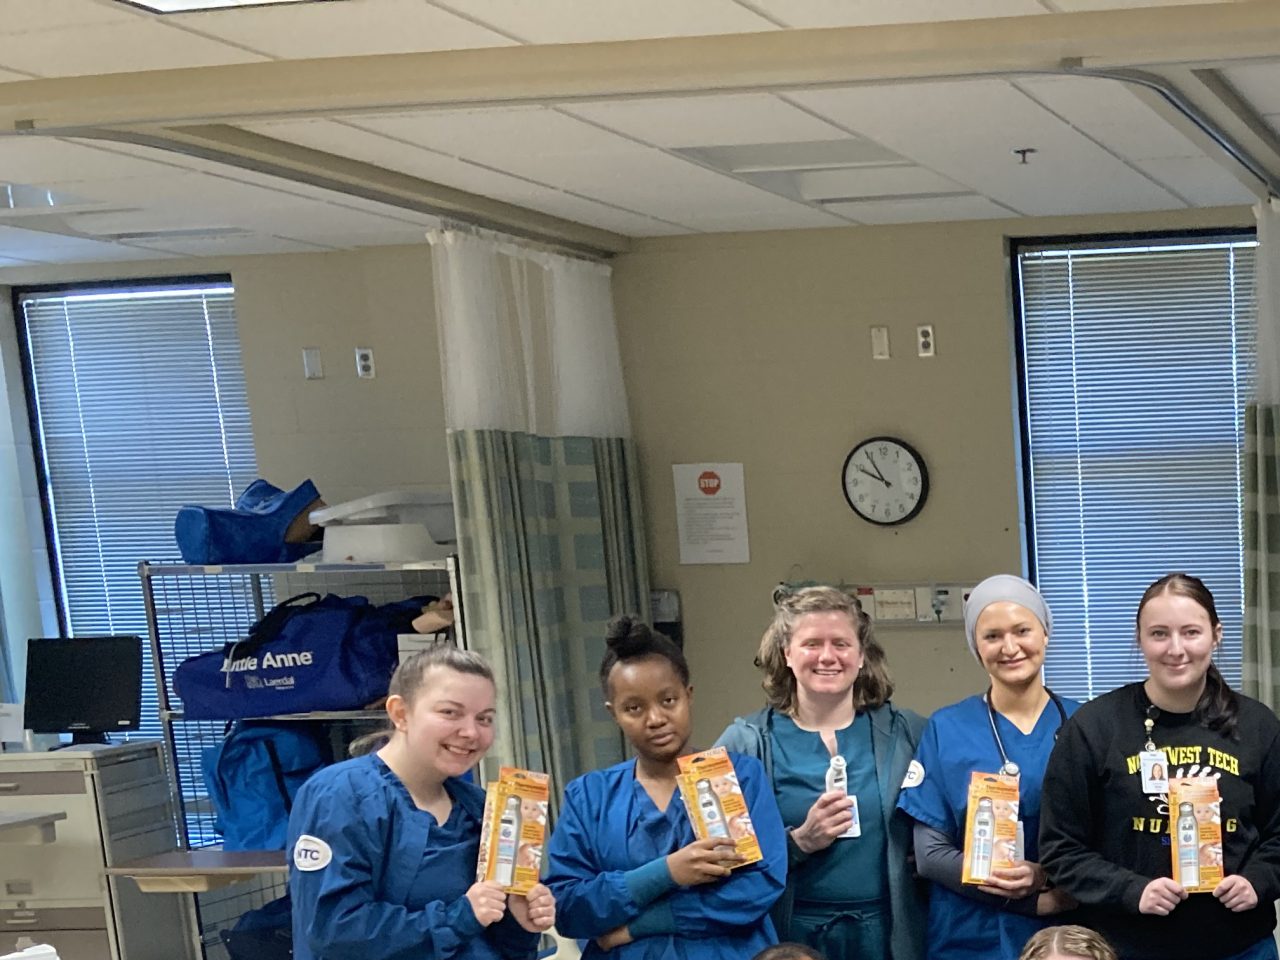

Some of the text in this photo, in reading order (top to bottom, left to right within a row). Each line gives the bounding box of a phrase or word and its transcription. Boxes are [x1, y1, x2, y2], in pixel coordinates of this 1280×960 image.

[700, 479, 720, 489] STOP
[262, 651, 313, 669] Anne
[1207, 747, 1240, 776] TECH
